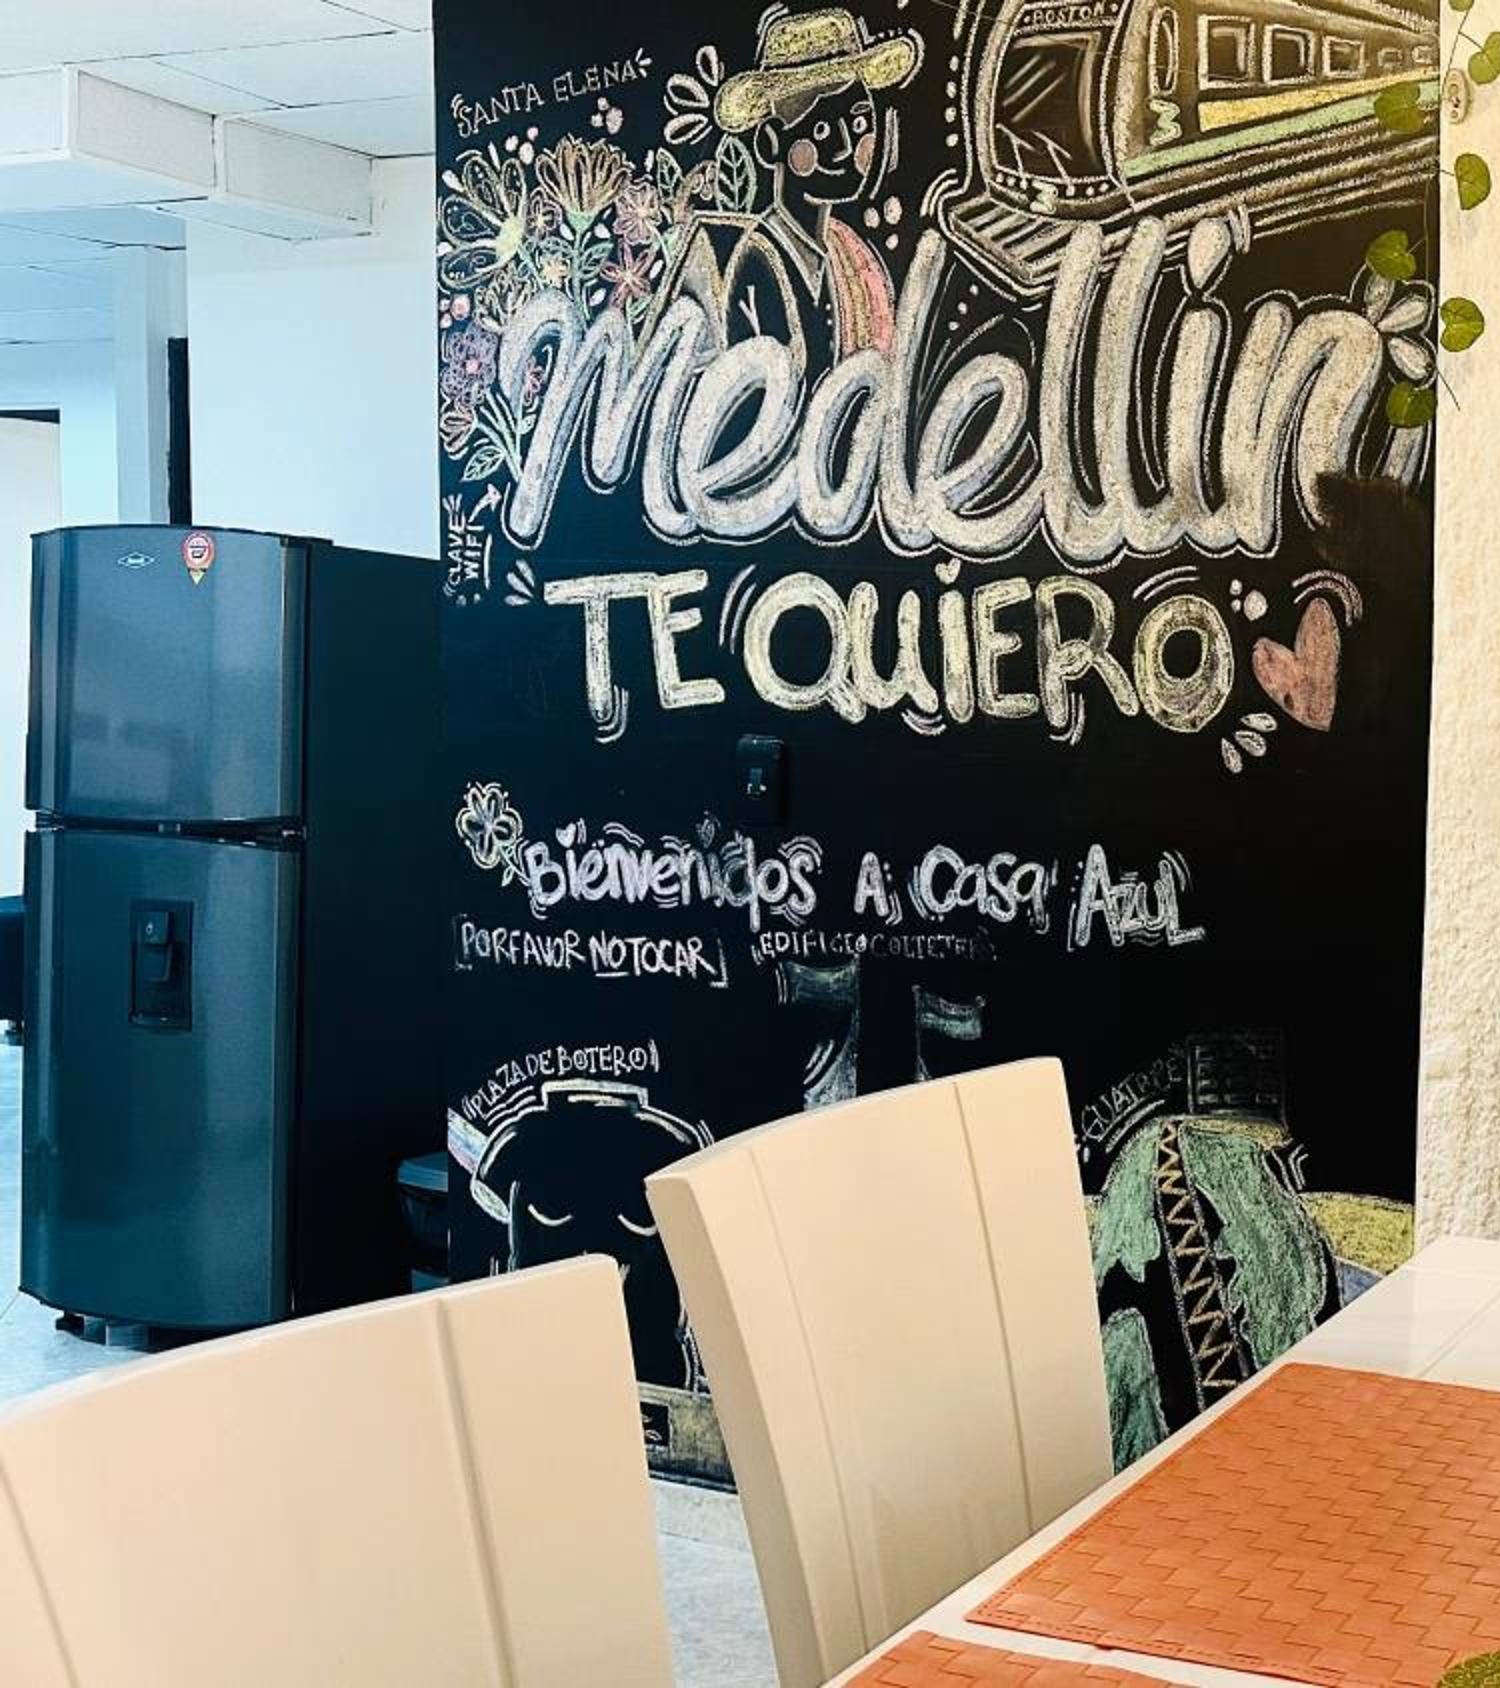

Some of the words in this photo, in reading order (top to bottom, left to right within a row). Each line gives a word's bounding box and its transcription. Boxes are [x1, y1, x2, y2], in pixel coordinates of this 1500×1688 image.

[457, 83, 544, 138] SANTA
[553, 60, 638, 102] ELENA
[448, 511, 465, 585] CLAVE
[464, 525, 484, 580] WIFI
[542, 567, 726, 722] TE
[742, 564, 1233, 733] QUIERO
[524, 823, 817, 932] Bienvenidos
[854, 852, 889, 916] A
[474, 1060, 528, 1120] PLAZA
[525, 1049, 555, 1077] DE
[556, 1044, 649, 1076] BOTERO
